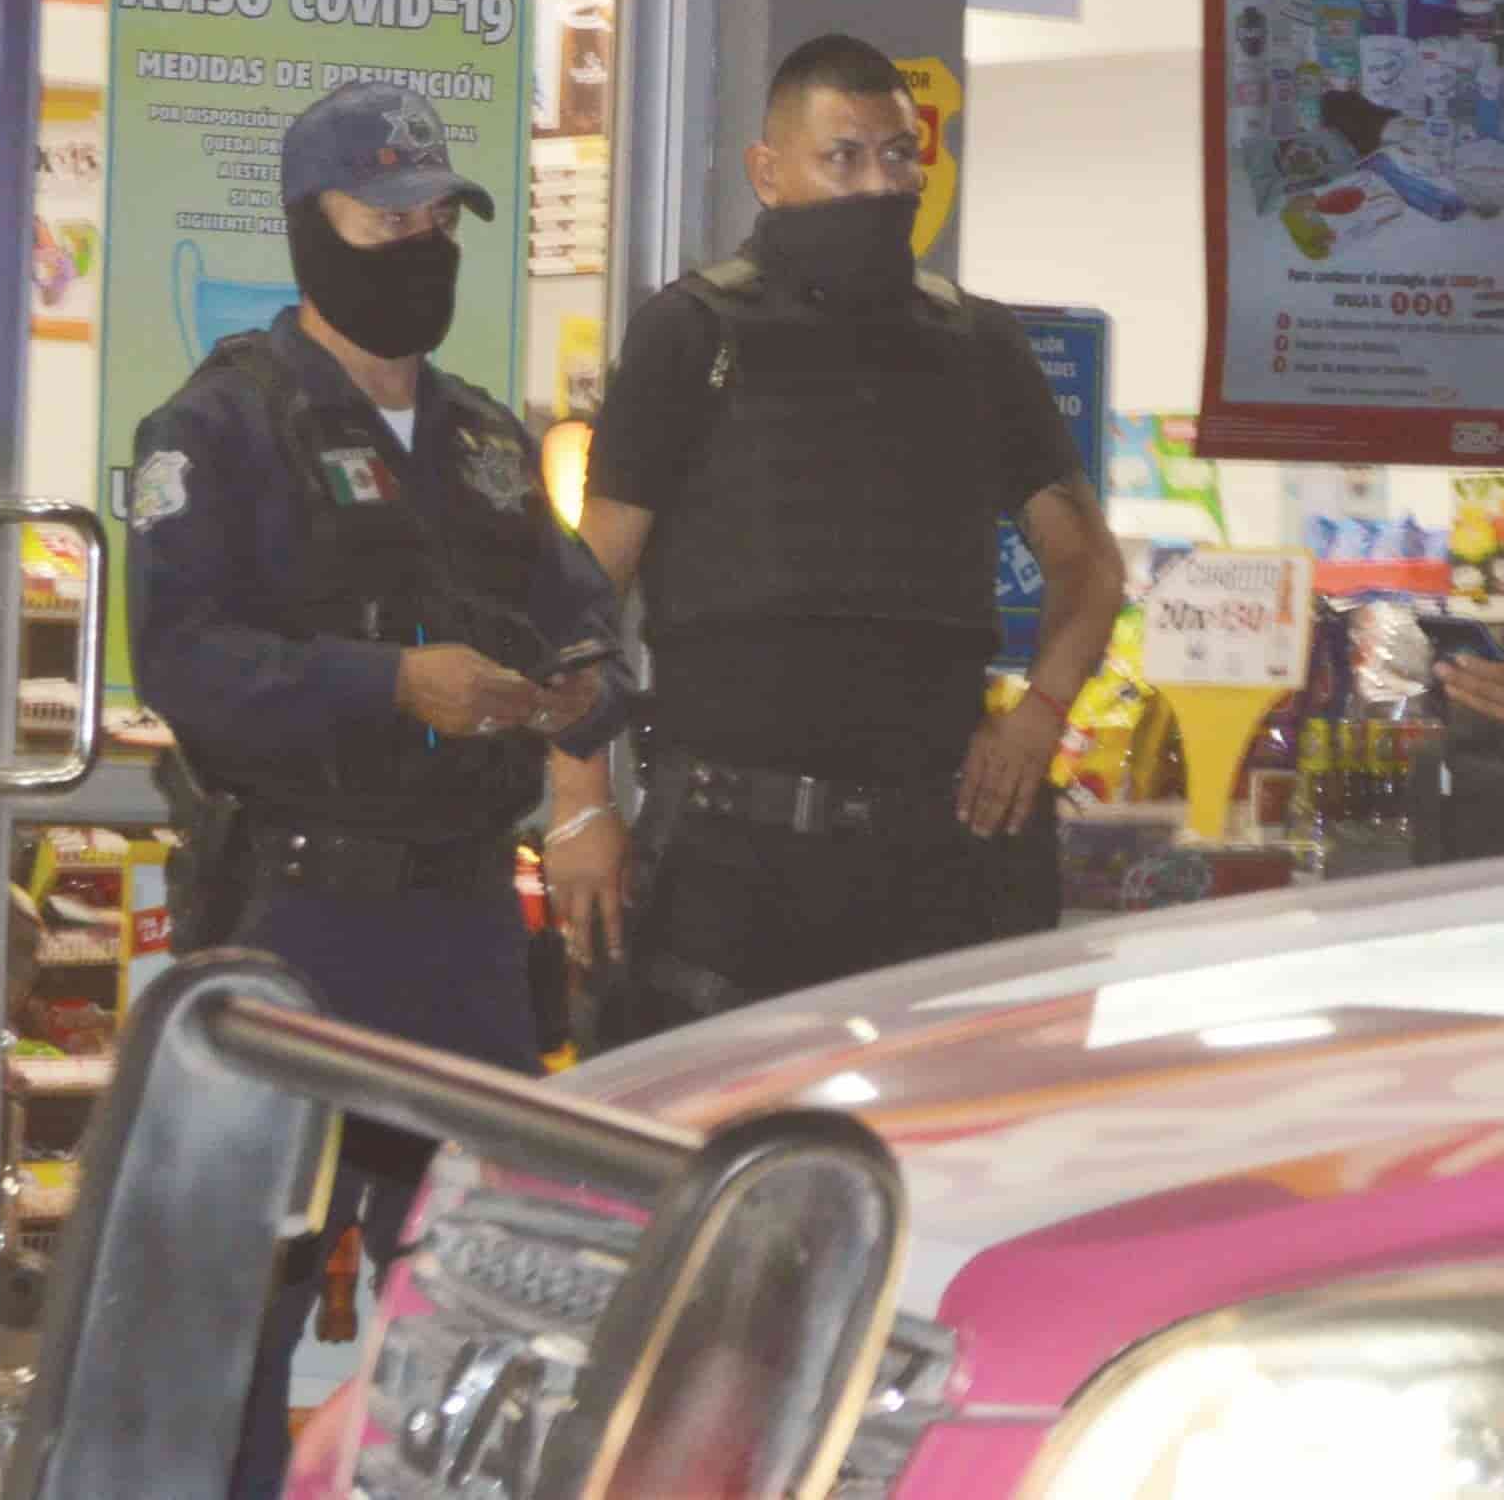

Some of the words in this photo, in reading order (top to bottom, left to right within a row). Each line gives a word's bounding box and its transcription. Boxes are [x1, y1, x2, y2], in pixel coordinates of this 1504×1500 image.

[137, 51, 265, 86] MEDIDAS
[276, 59, 314, 90] DE
[149, 103, 182, 122] POR
